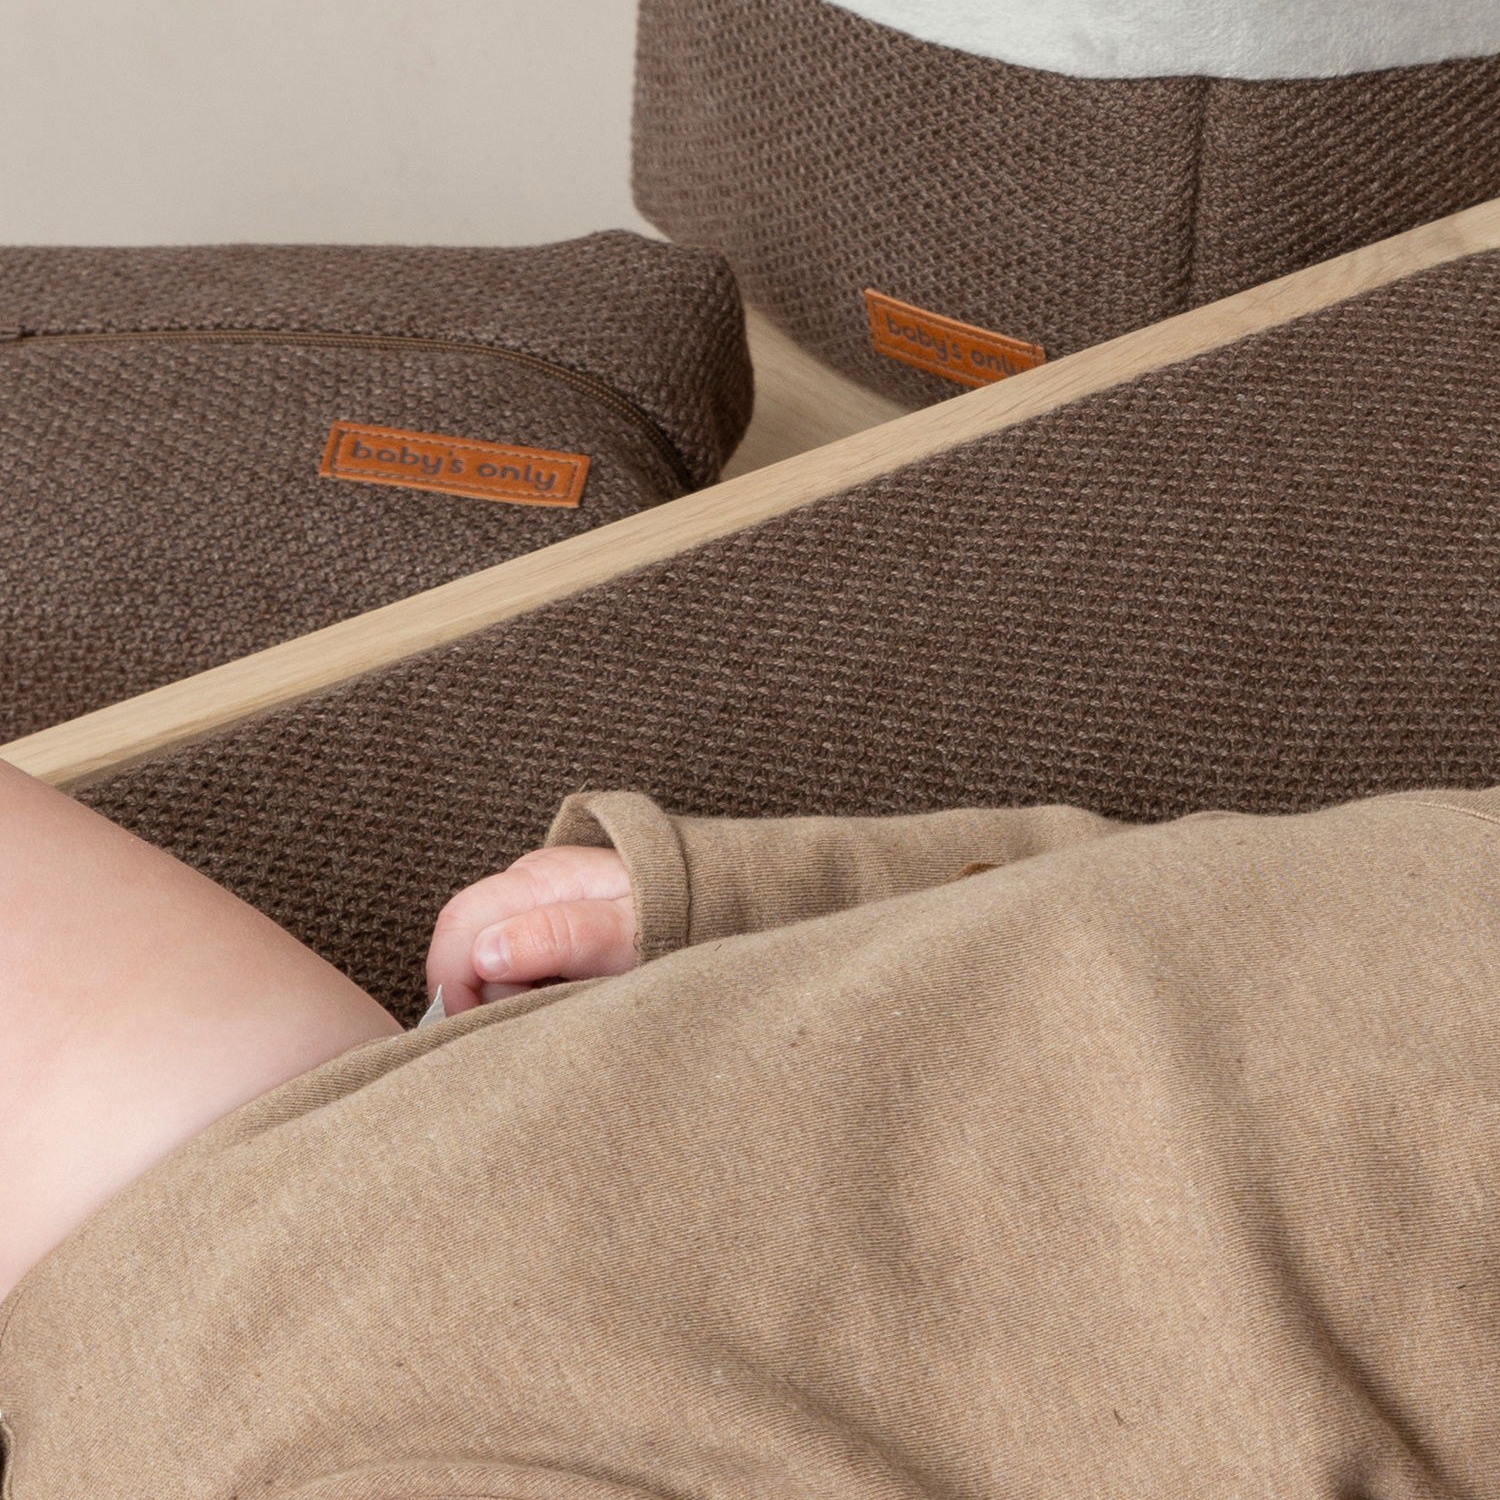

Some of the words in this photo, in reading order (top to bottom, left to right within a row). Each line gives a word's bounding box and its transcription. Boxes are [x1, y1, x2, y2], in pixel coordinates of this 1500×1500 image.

[886, 312, 962, 362] baby's
[351, 440, 465, 476] baby's
[477, 462, 558, 492] only
